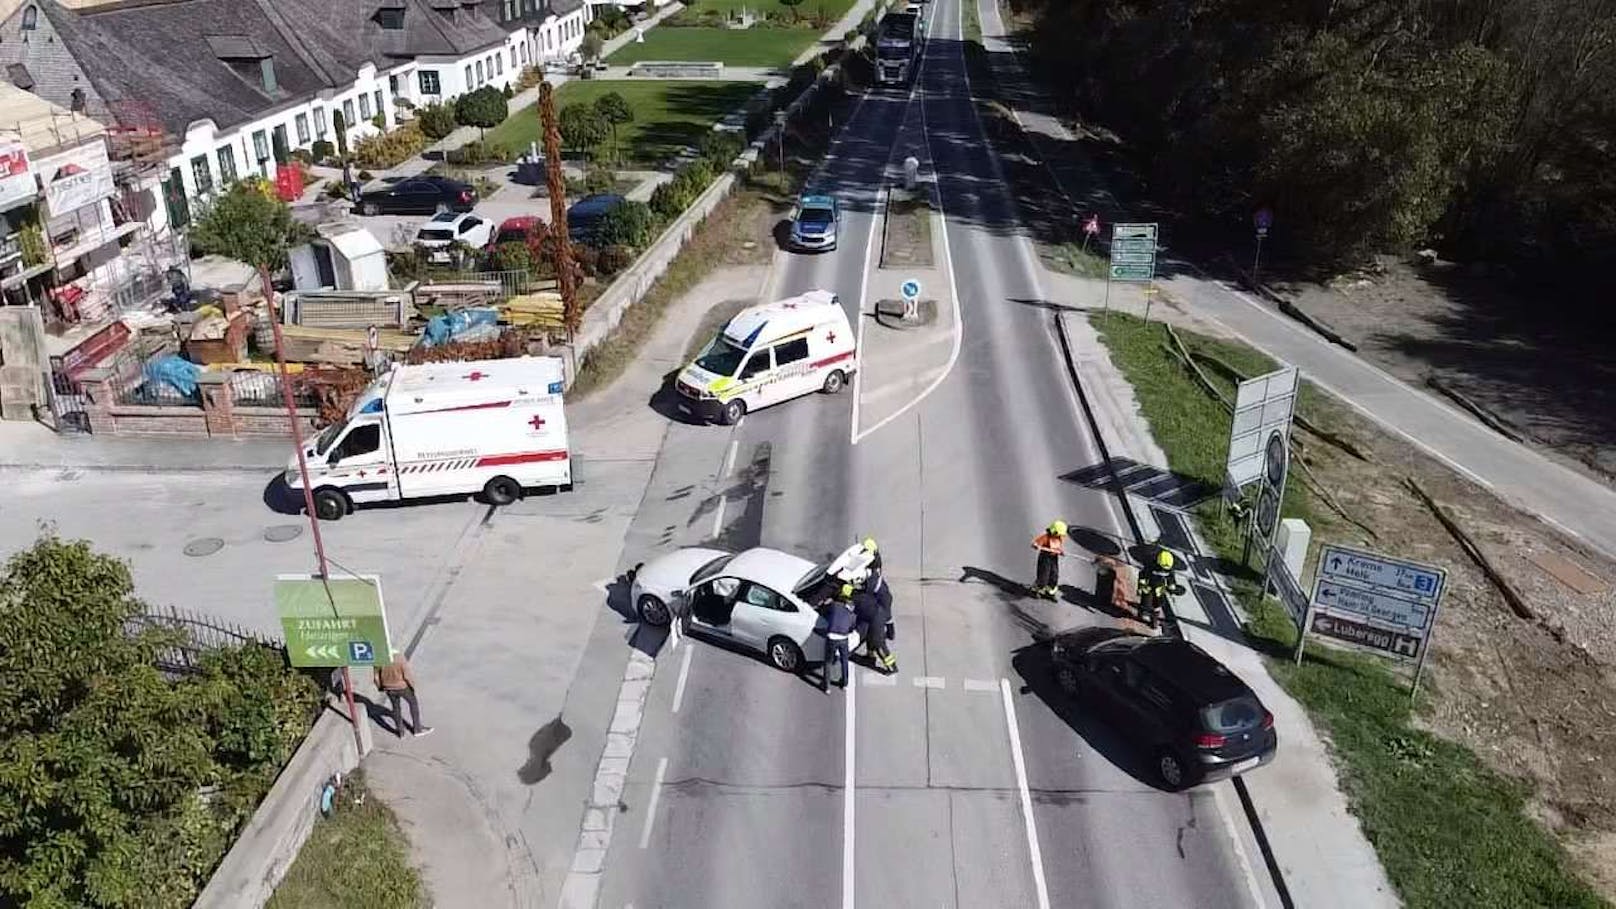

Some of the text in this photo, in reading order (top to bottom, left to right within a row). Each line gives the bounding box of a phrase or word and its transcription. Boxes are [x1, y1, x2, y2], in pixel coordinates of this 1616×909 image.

[299, 618, 357, 630] ZUFAHRT
[1333, 619, 1390, 648] Luberegg
[353, 642, 367, 660] P
